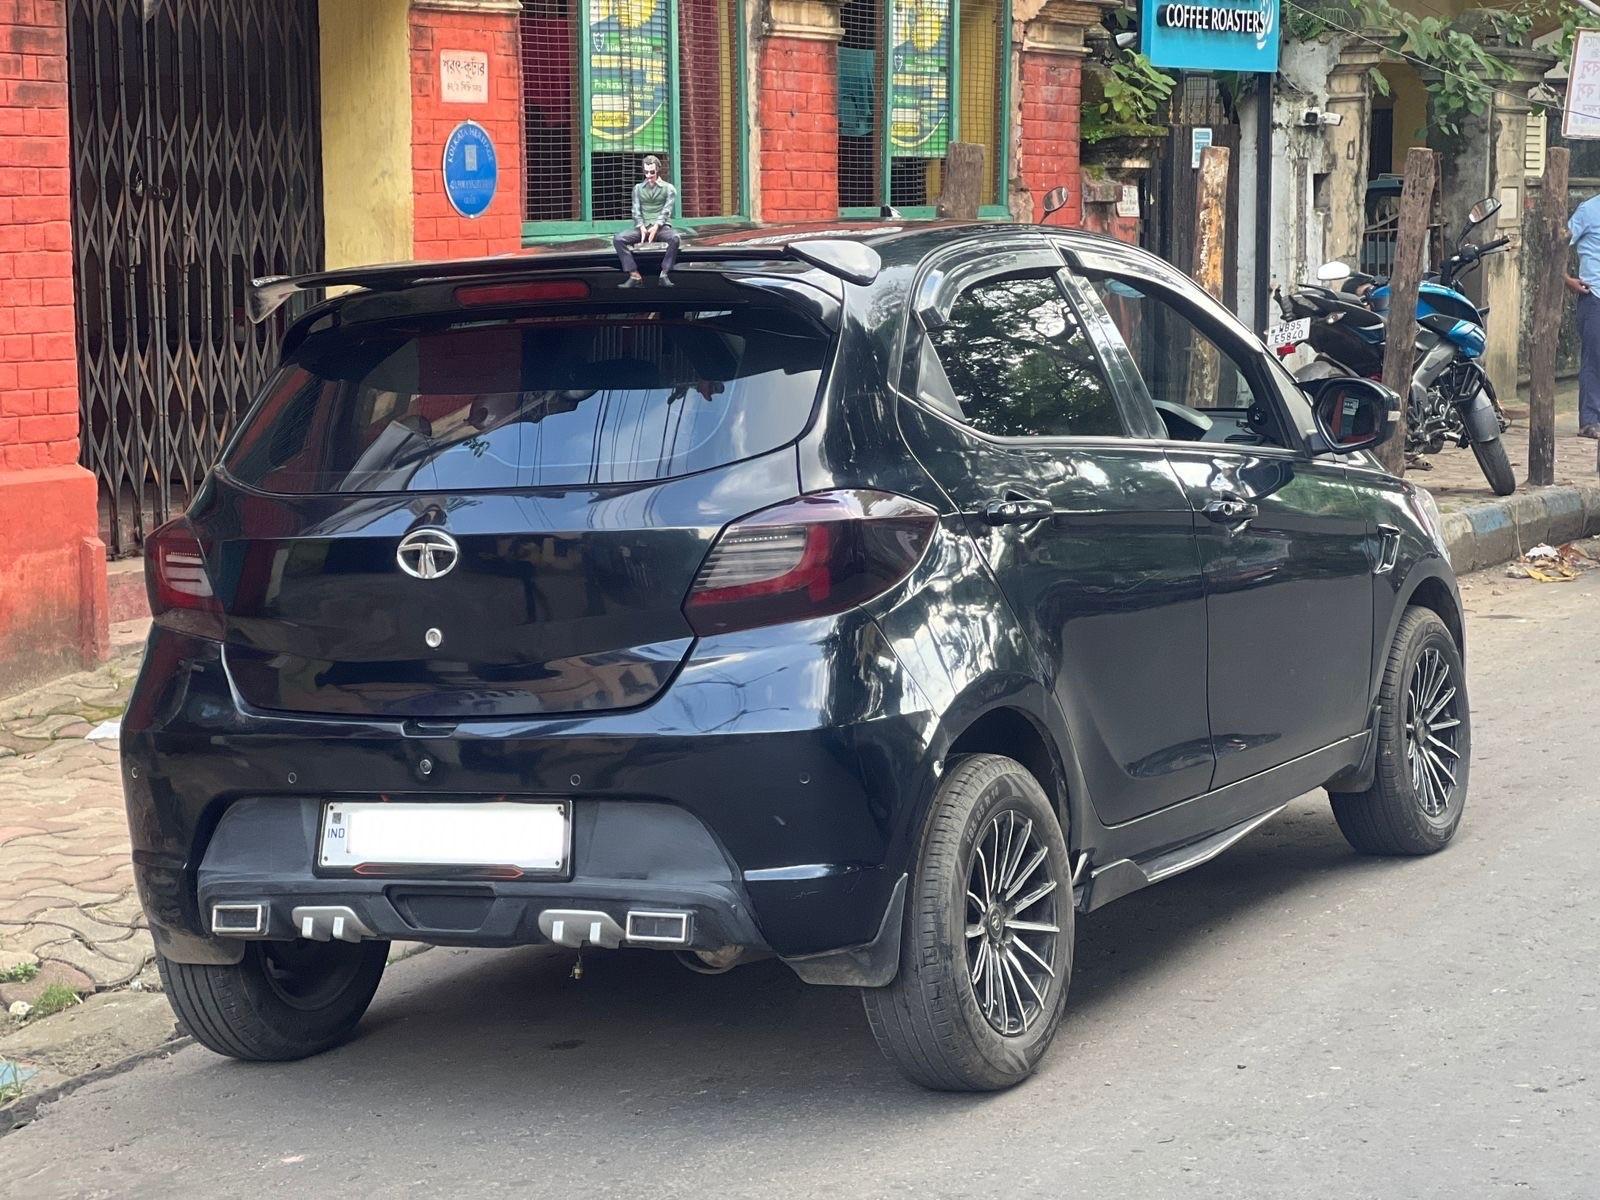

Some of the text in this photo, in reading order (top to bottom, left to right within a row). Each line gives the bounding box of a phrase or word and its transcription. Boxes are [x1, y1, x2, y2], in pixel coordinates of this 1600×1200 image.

[1166, 4, 1265, 33] COFFEE ROASTERS
[1279, 321, 1302, 333] WB95
[1274, 329, 1304, 343] E5840
[327, 827, 345, 838] IND
